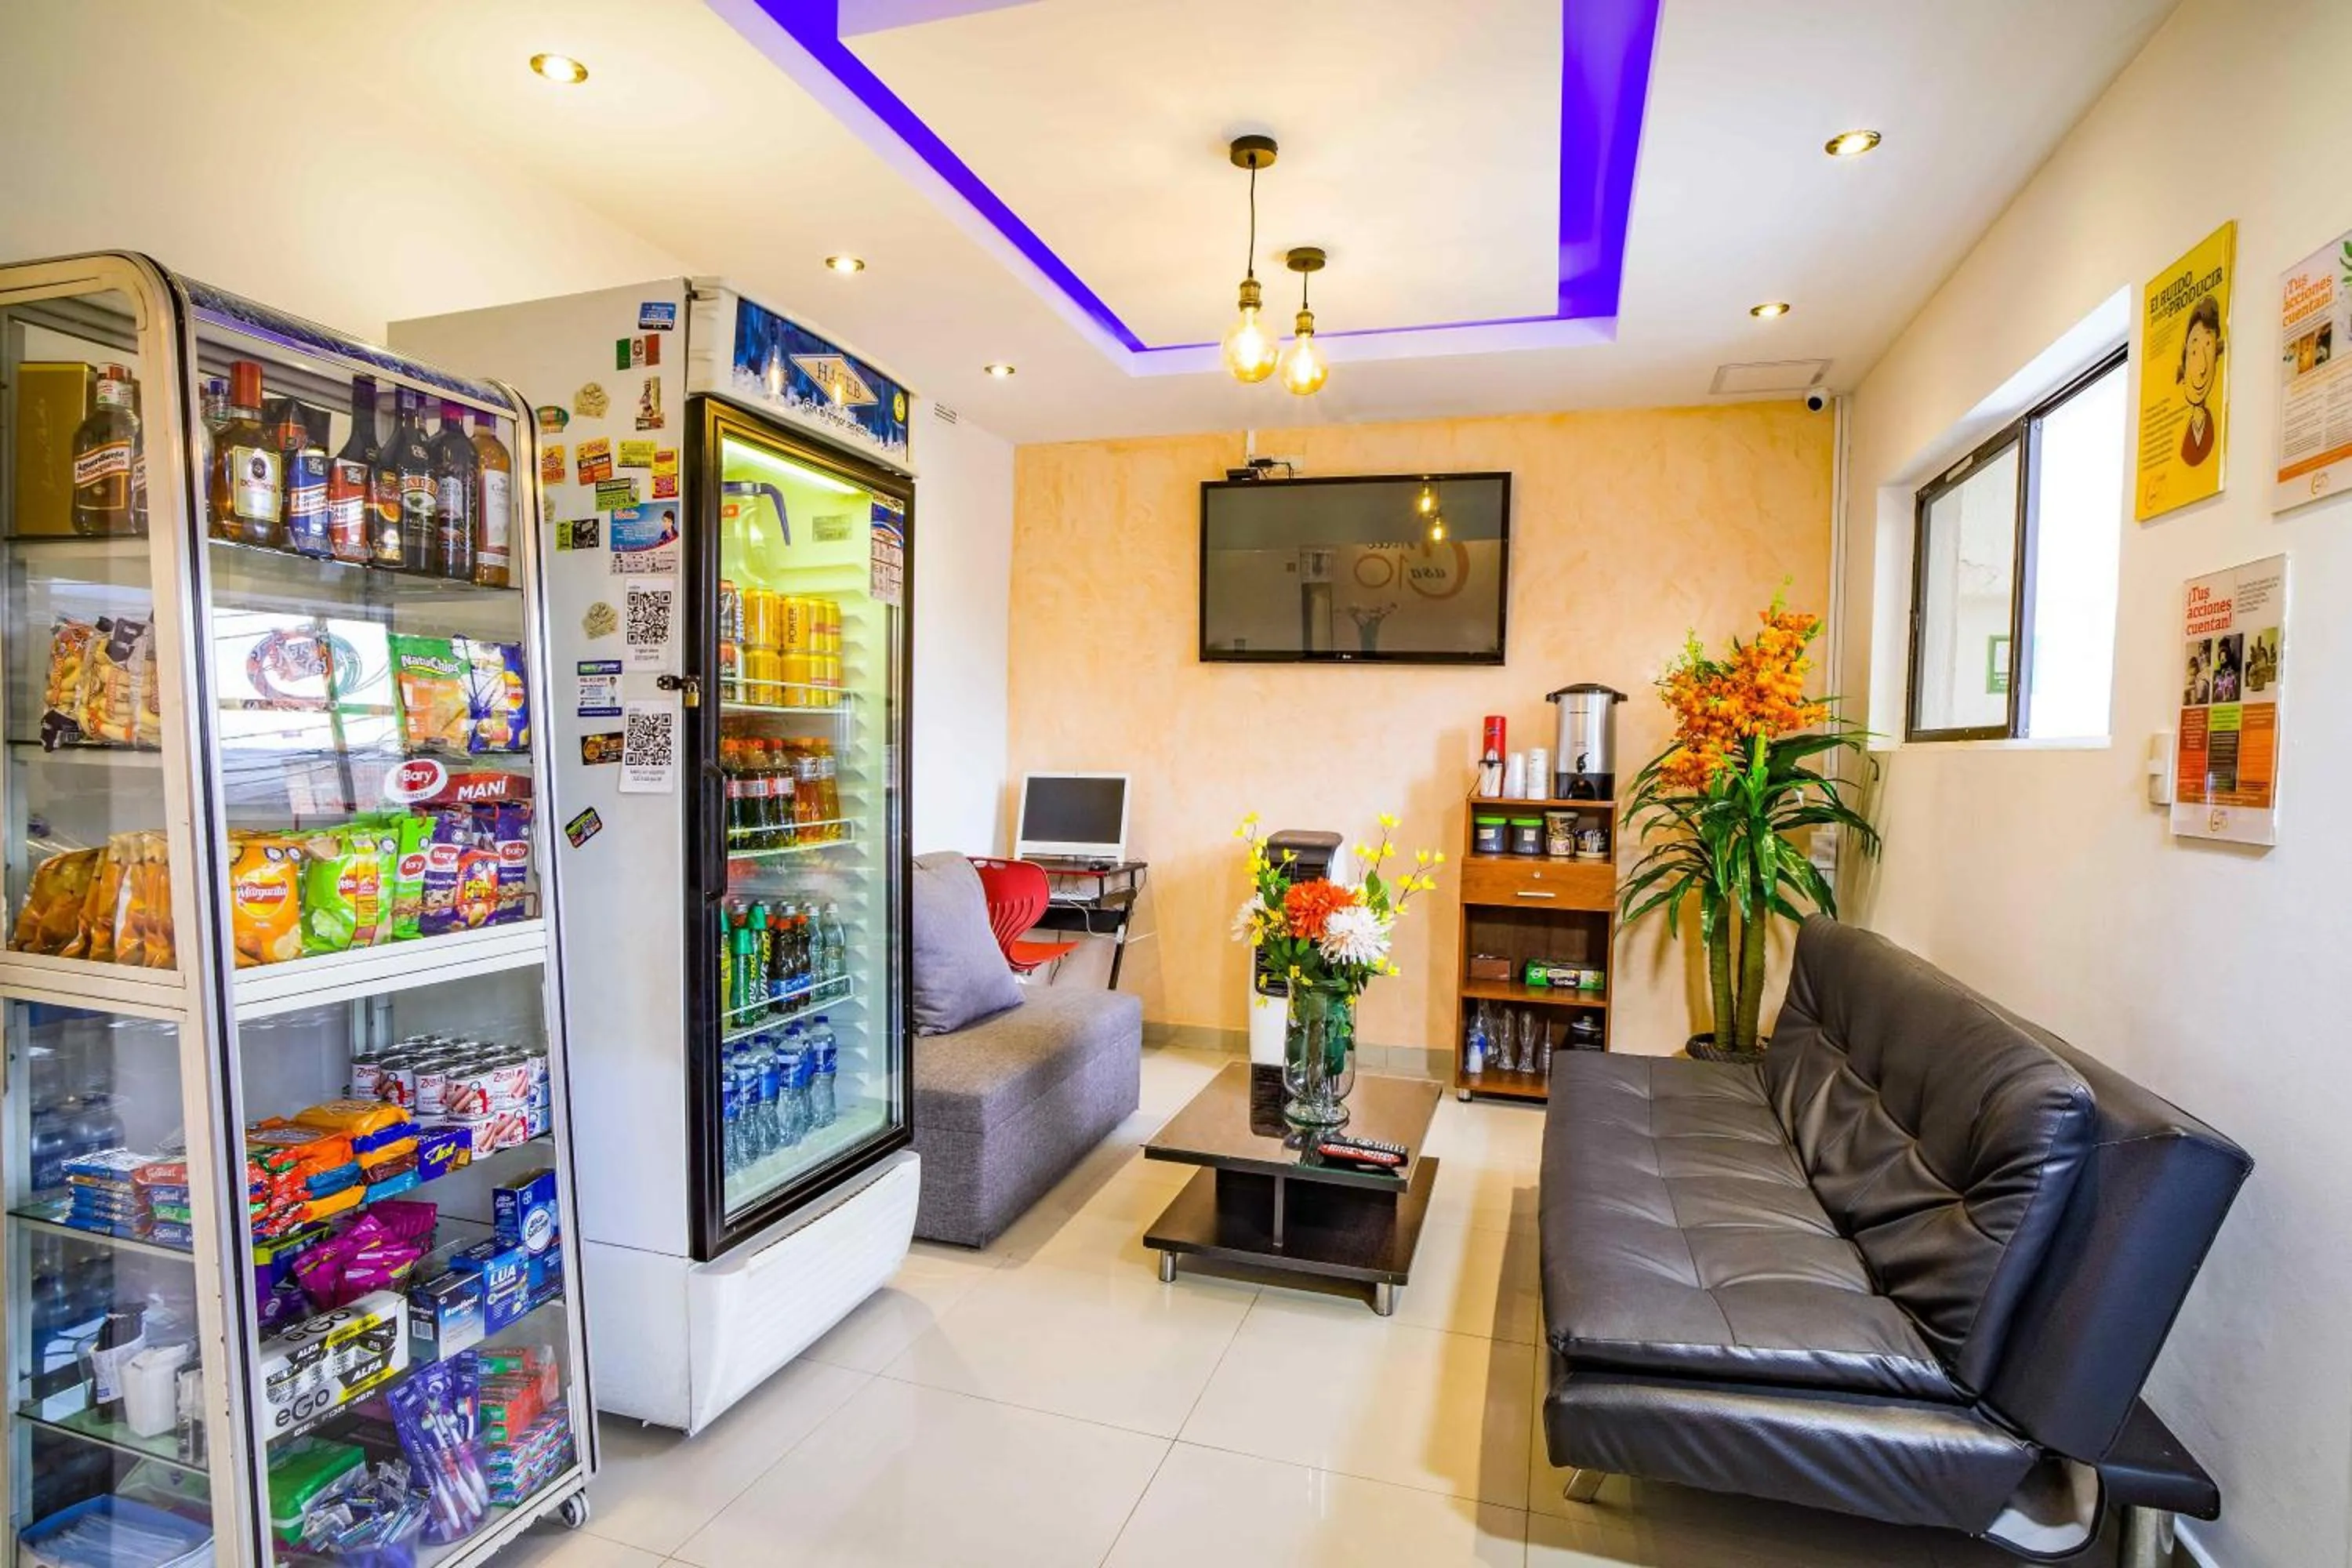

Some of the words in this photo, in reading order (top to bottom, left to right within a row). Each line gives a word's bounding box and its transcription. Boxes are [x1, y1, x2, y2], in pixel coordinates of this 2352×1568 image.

[2161, 270, 2193, 306] RUIDO
[2168, 267, 2223, 318] PRODUCIR
[2282, 274, 2333, 313] acciones
[2282, 285, 2333, 327] cuentan!
[2188, 586, 2210, 607] ¡Tus
[2187, 599, 2232, 619] acciones
[2187, 612, 2232, 635] cuentan!
[401, 654, 459, 673] NatuChips
[402, 768, 433, 783] Bary
[457, 775, 508, 800] MANÍ
[489, 1265, 515, 1287] LUA
[296, 1343, 320, 1359] ALFA
[351, 1359, 383, 1383] ALFA
[275, 1388, 330, 1427] eGo
